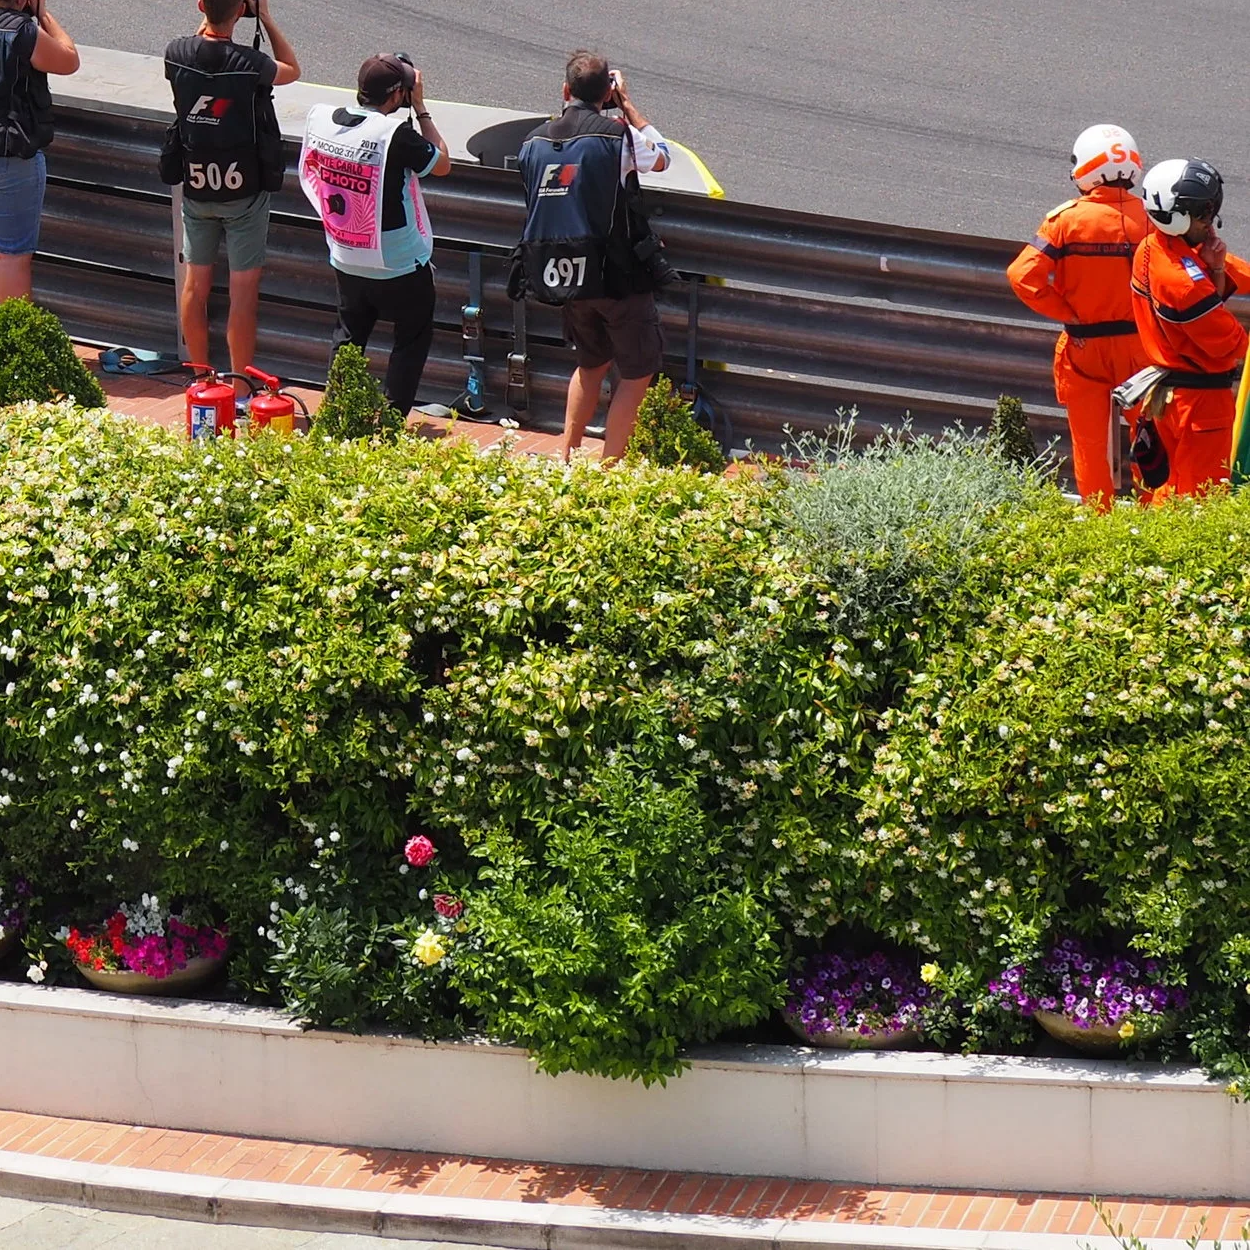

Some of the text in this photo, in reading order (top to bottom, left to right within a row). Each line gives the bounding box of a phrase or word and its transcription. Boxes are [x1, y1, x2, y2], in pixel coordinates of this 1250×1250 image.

[361, 140, 378, 150] 2017
[189, 161, 244, 190] 506
[323, 171, 368, 191] PHOTO
[543, 256, 587, 287] 697
